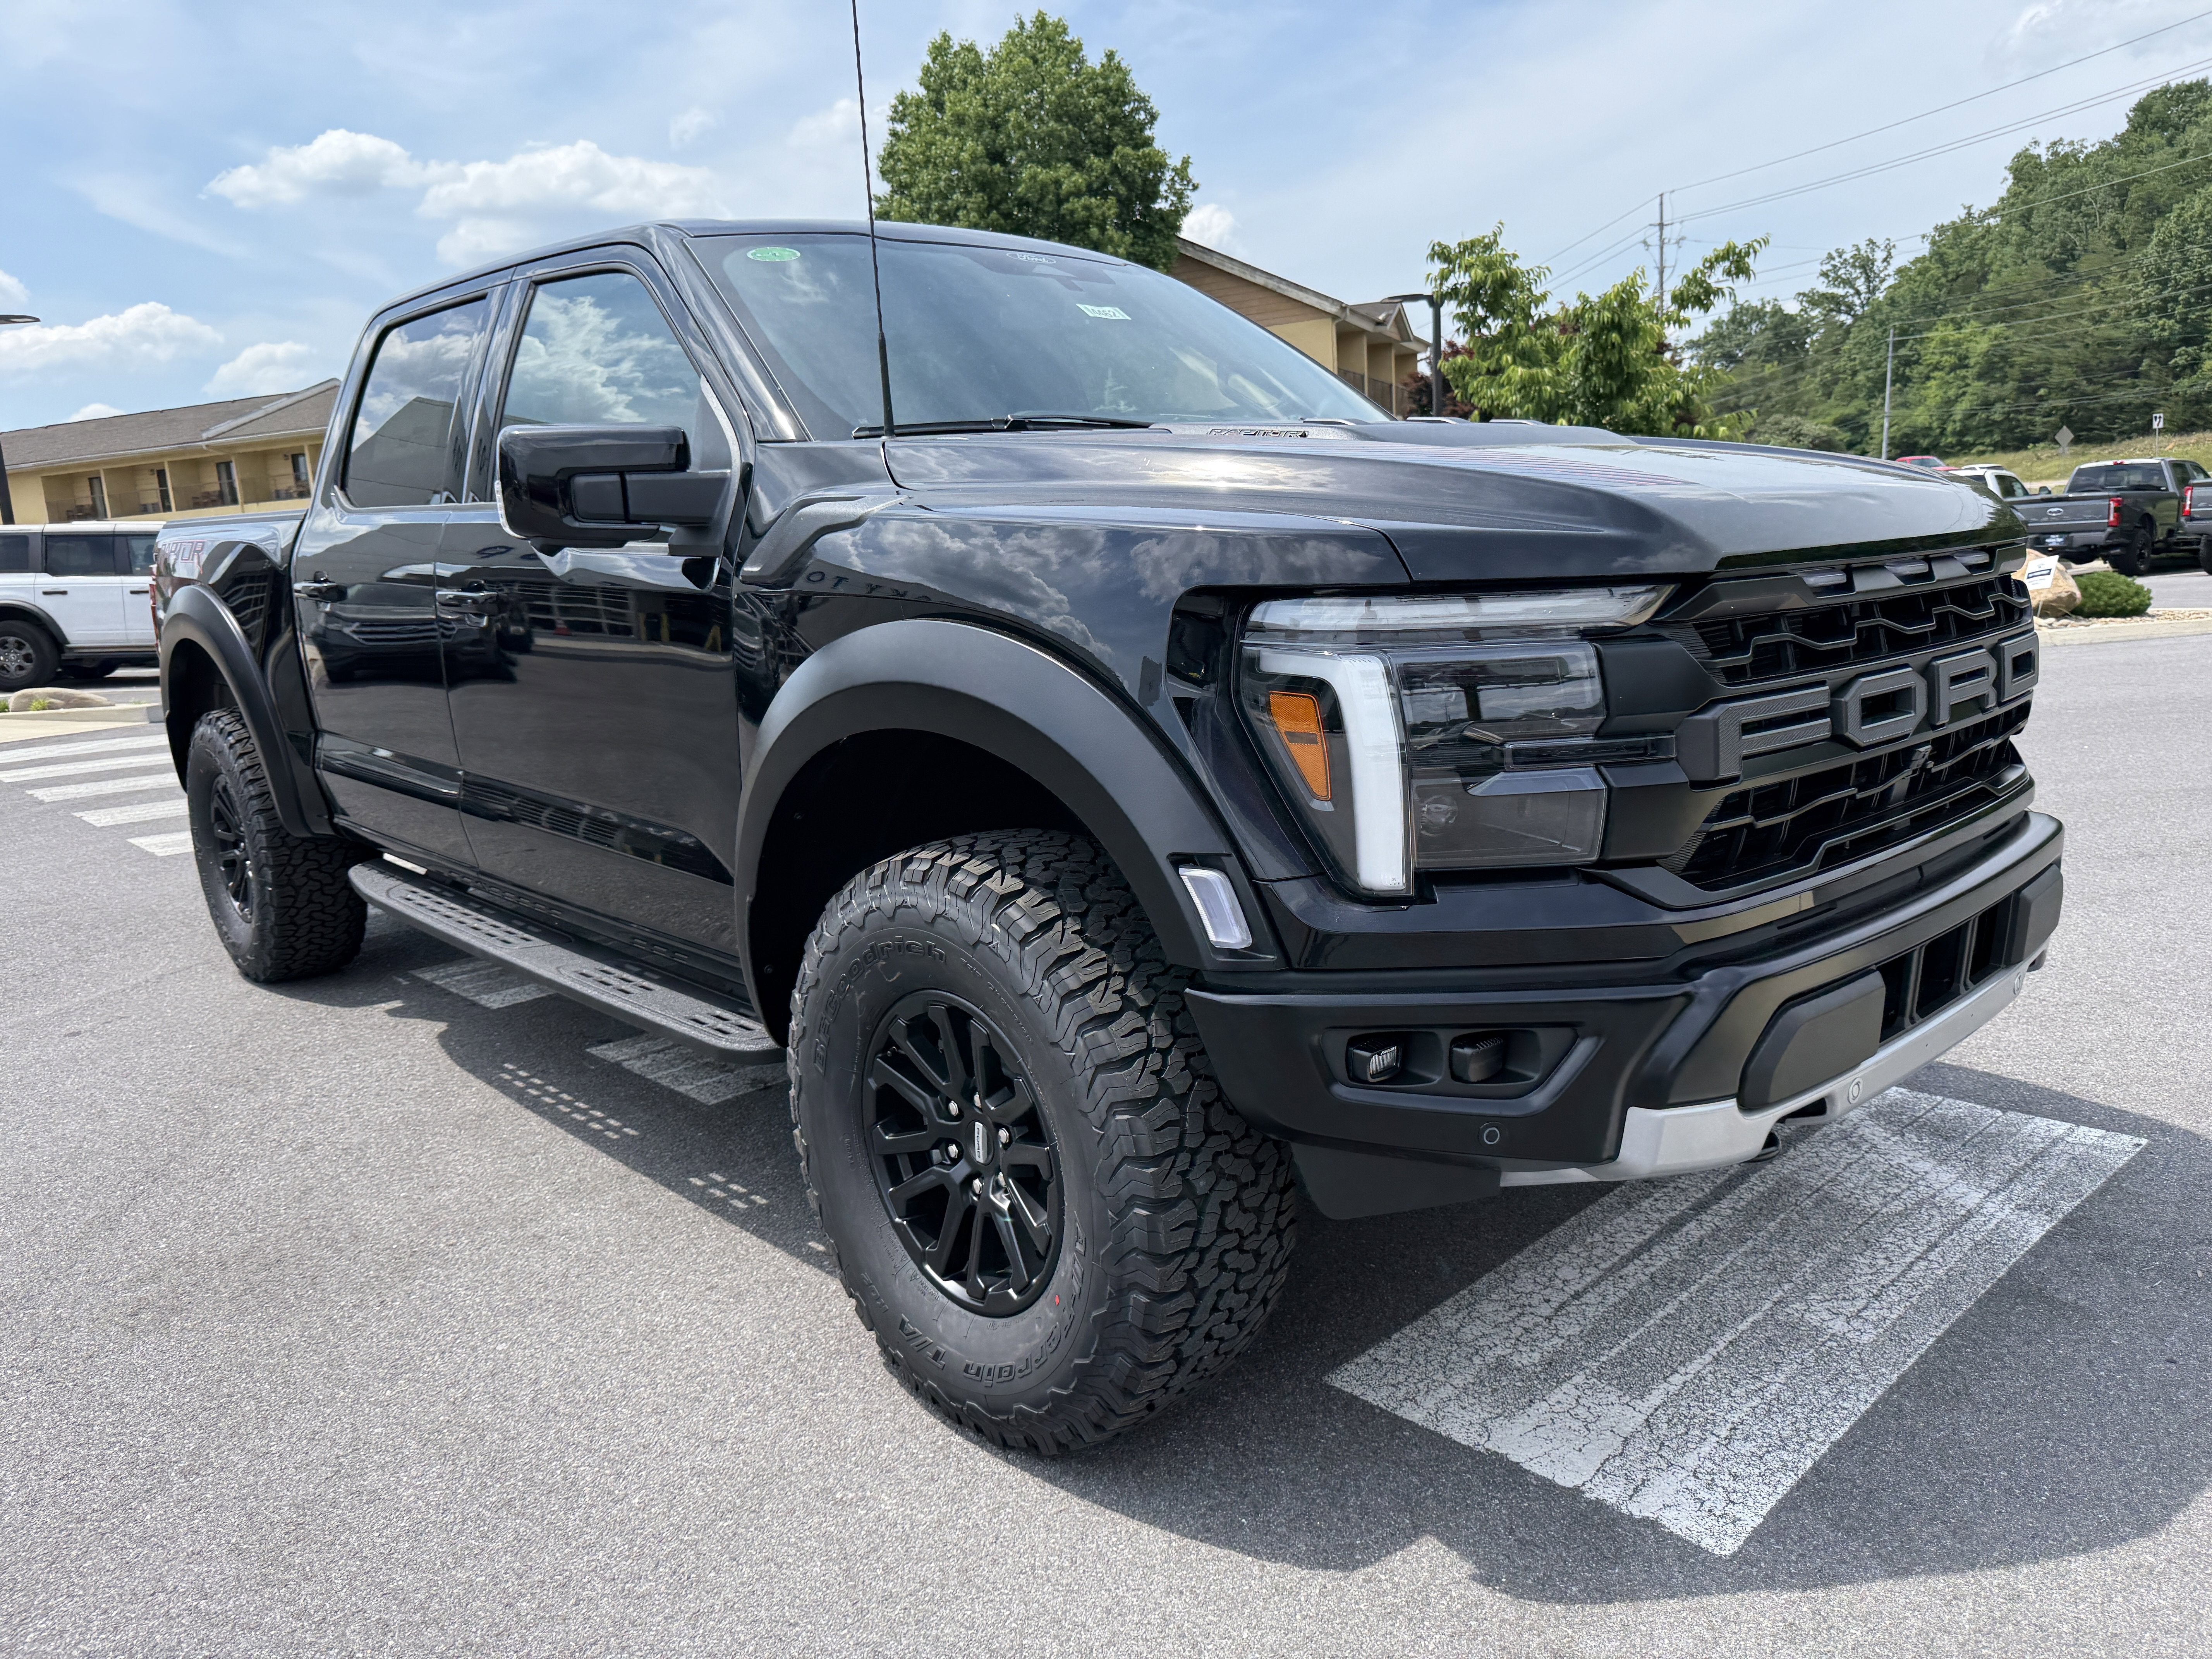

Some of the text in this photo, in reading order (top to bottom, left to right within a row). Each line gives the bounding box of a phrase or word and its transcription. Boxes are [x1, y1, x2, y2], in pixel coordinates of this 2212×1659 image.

[1712, 632, 2039, 781] FORD
[813, 935, 947, 1077] BFGoodrich
[898, 1313, 947, 1371] T/A
